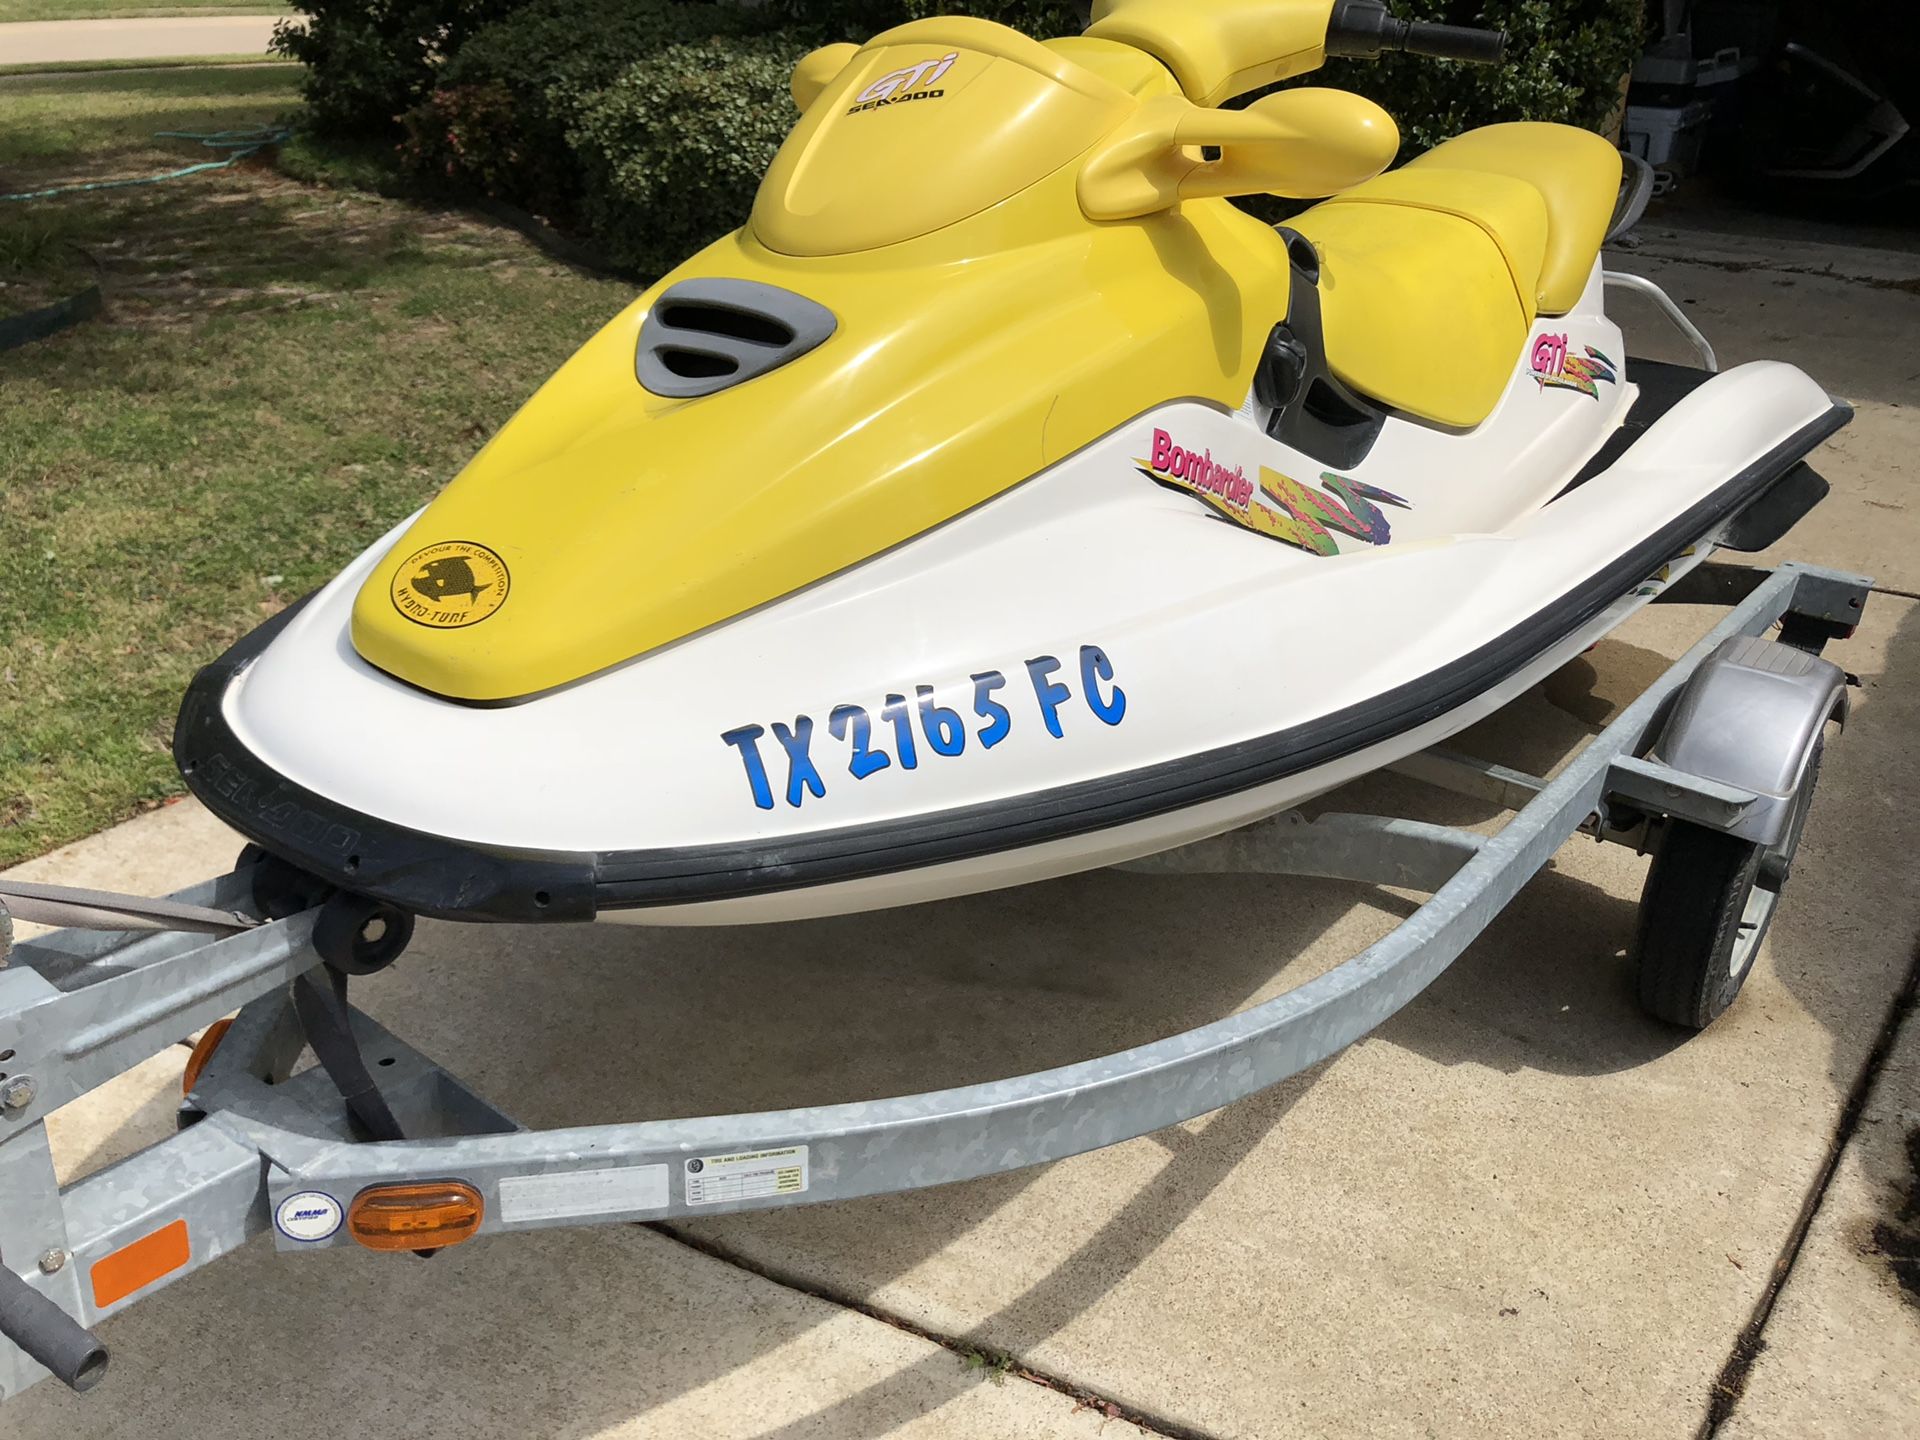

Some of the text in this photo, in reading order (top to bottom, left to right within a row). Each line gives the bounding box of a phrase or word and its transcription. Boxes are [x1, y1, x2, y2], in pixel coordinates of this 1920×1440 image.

[1151, 428, 1254, 511] Bombardier
[411, 545, 506, 597] DEVOUR THE COMPETITION
[720, 714, 826, 810] TX
[828, 670, 1011, 780] 2165
